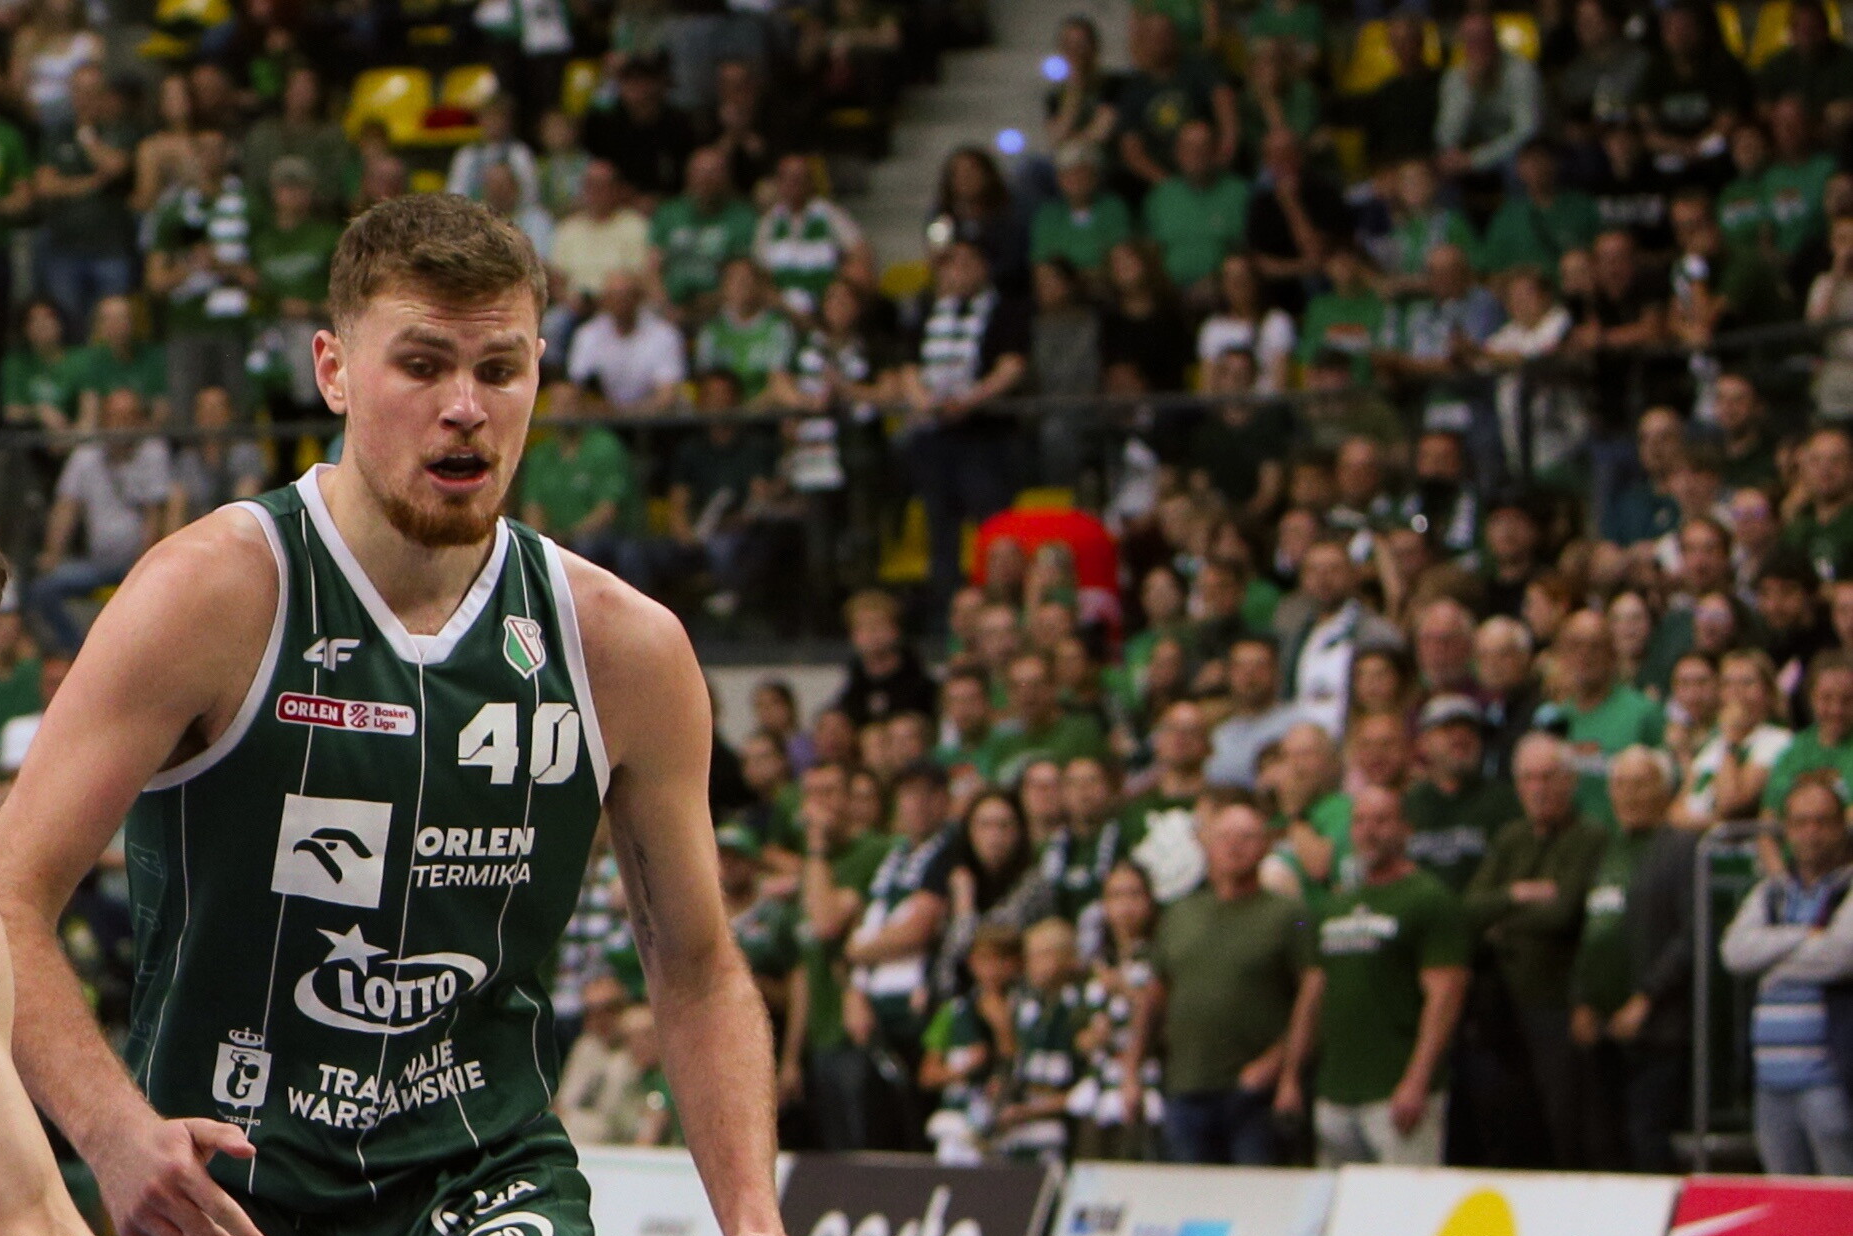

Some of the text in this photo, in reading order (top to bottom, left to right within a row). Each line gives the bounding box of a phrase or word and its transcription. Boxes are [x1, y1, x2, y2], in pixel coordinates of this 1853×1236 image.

[303, 637, 360, 672] 4F
[284, 700, 339, 721] ORLEN
[374, 706, 409, 719] Basket
[374, 718, 397, 731] Liga
[458, 702, 580, 784] 40
[416, 826, 535, 857] ORLEN
[411, 862, 531, 888] TERMIKA
[338, 969, 458, 1019] LOTTO
